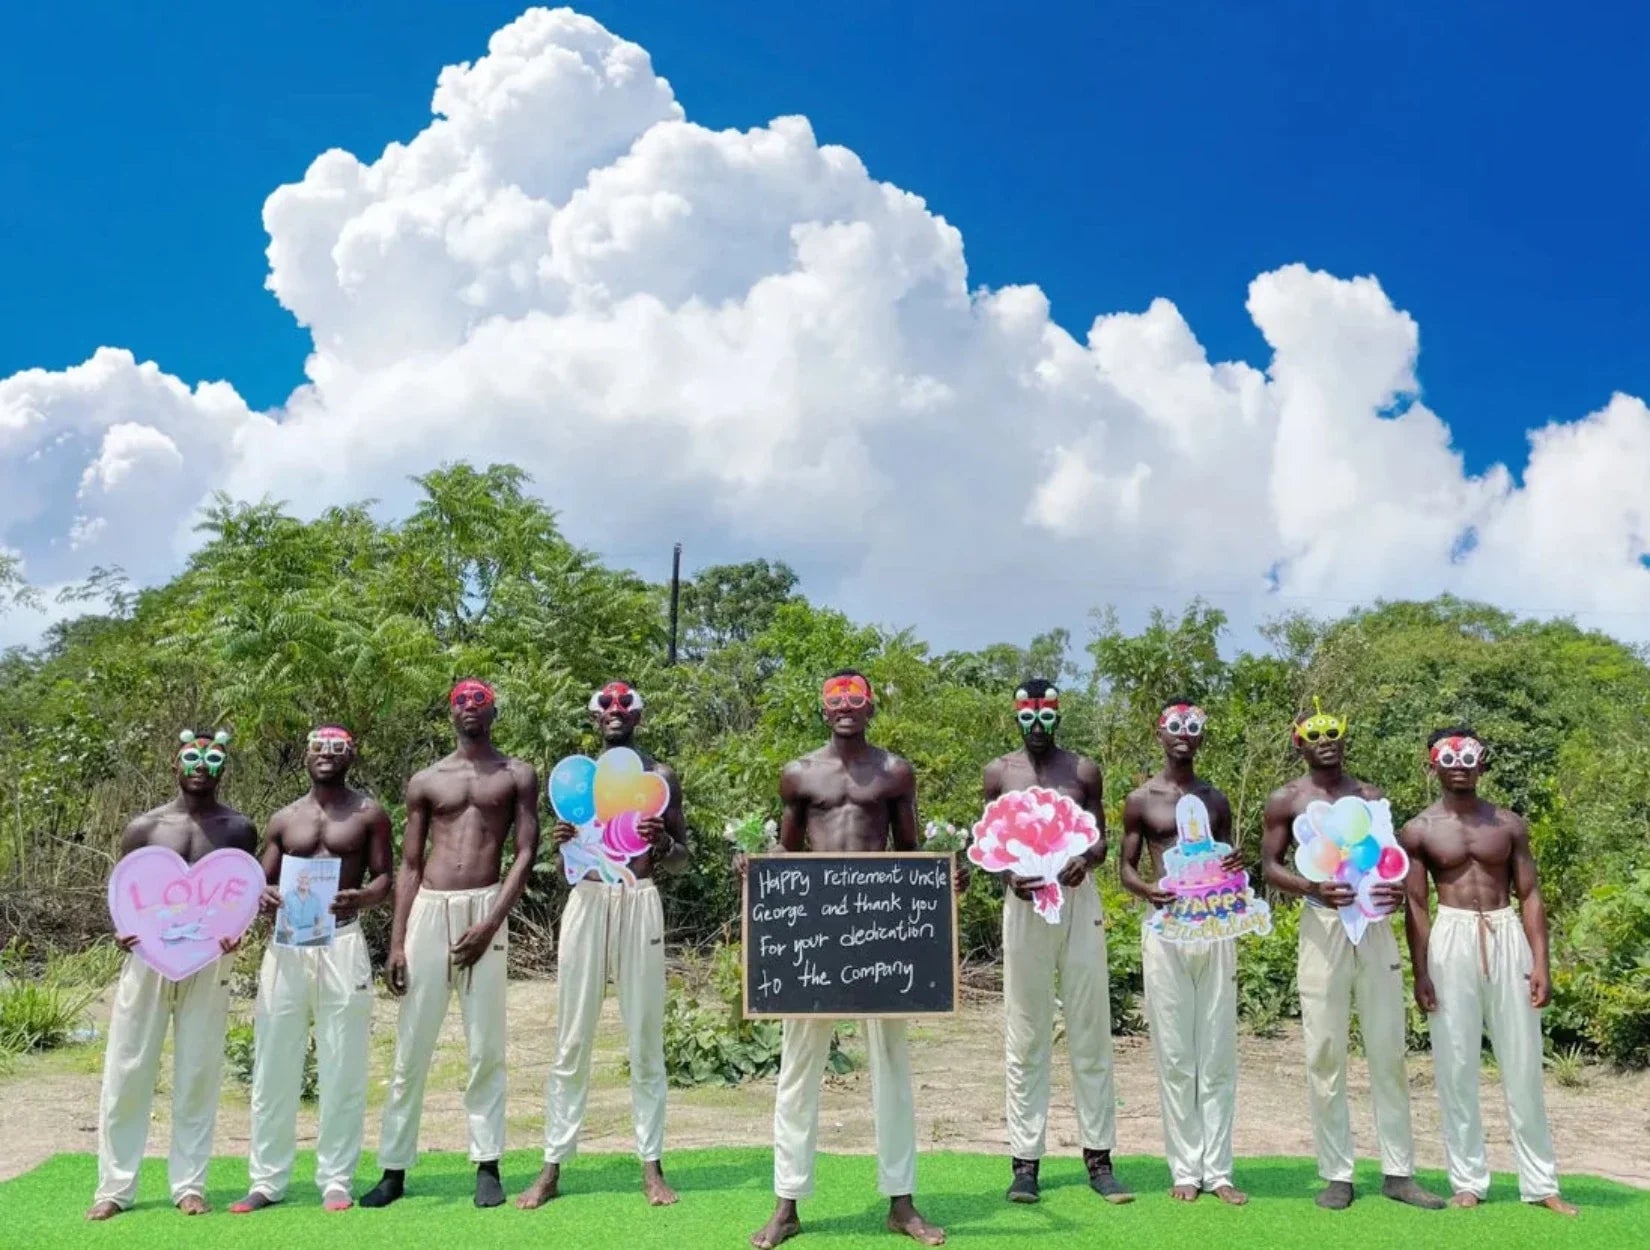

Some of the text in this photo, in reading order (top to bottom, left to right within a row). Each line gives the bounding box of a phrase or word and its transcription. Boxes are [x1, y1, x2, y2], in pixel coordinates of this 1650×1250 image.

[759, 869, 810, 899] Happy
[823, 864, 904, 886] retirement
[752, 892, 938, 927] George and thank you
[792, 932, 830, 967] your
[839, 920, 935, 947] dedication
[757, 969, 782, 998] to
[797, 960, 832, 987] the
